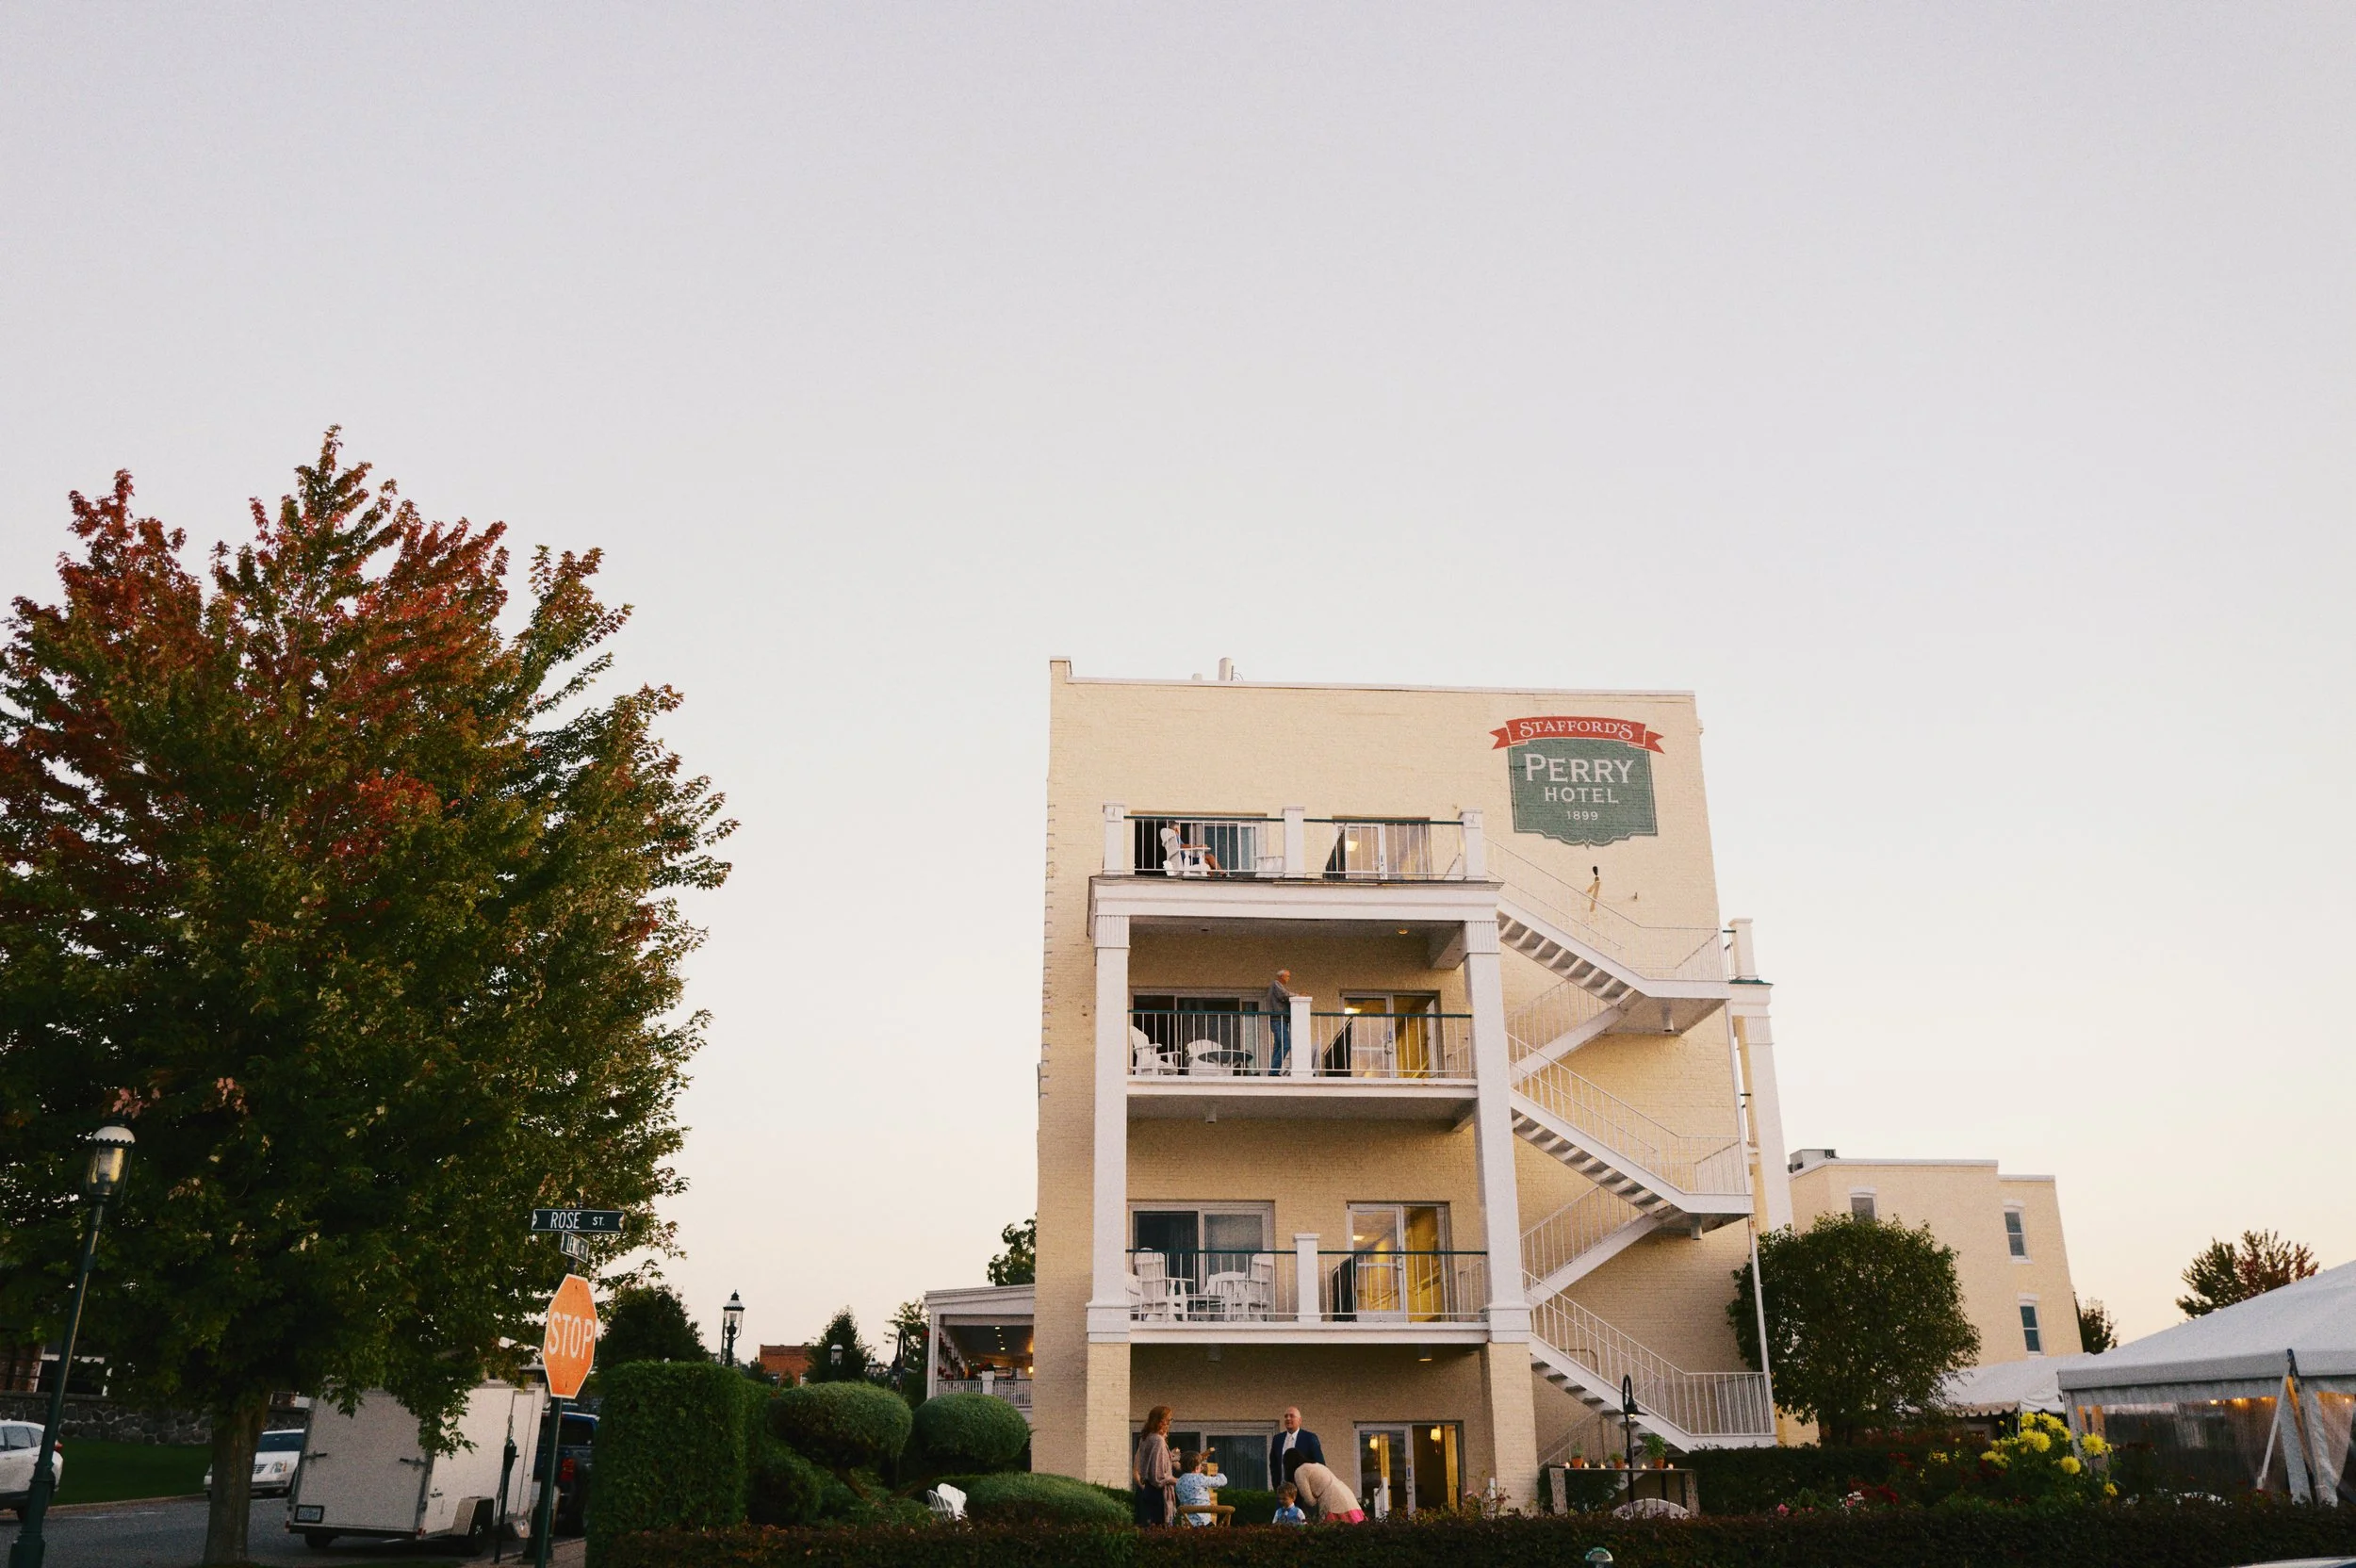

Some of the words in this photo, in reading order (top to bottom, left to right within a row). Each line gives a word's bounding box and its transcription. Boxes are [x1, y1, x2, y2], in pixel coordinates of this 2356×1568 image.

[1519, 720, 1633, 740] STAFFORD'S
[1524, 753, 1635, 784] PERRY
[1545, 787, 1619, 804] HOTEL
[1566, 810, 1598, 821] 1899
[549, 1211, 581, 1230] ROSE
[548, 1311, 594, 1360] STOP
